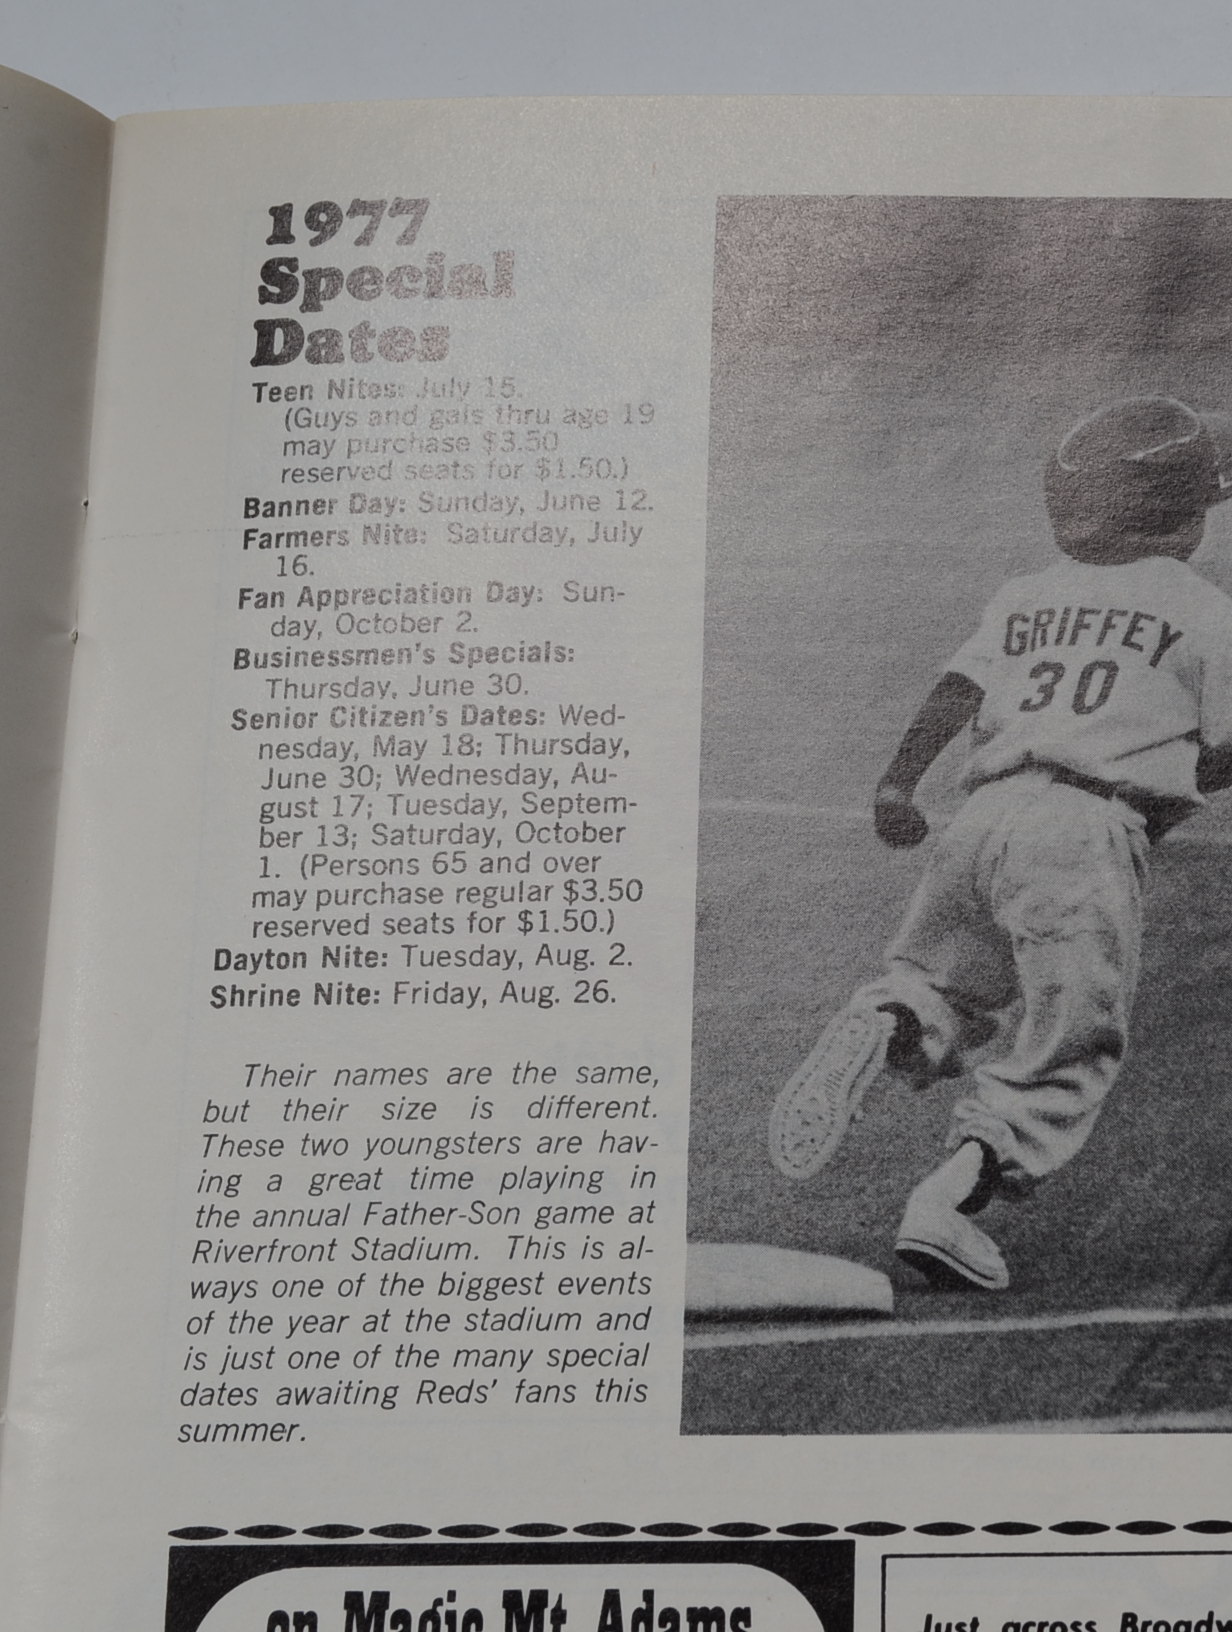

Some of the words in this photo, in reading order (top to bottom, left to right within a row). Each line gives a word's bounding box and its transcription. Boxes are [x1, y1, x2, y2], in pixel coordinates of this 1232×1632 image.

[266, 198, 430, 247] 1977
[258, 250, 516, 312] Special
[250, 318, 450, 367] Dates
[252, 382, 312, 403] Teen
[328, 379, 405, 401] Nites:
[416, 376, 470, 402] July
[285, 407, 357, 432] (Guys
[369, 404, 418, 427] and
[496, 404, 553, 426] thru
[562, 408, 608, 429] age
[624, 402, 655, 425] 19
[283, 440, 335, 460] may
[346, 432, 470, 459] purchase
[281, 460, 392, 484] reserved
[405, 460, 475, 480] seats
[487, 458, 523, 480] for
[535, 456, 629, 482] $1.50.)
[244, 497, 333, 519] Banner
[349, 492, 405, 518] Day:
[418, 491, 525, 516] Sunday,
[537, 490, 601, 512] June
[616, 489, 653, 511] 12.
[243, 528, 348, 550] Farmers
[363, 523, 426, 545] Nite:
[447, 521, 575, 548] Saturday,
[588, 520, 643, 547] July
[278, 554, 314, 577] 16.
[239, 588, 284, 609] Fan
[297, 582, 471, 612] Appreciation
[486, 581, 543, 608] Day:
[563, 580, 625, 603] Sun-
[271, 615, 322, 641] day,
[335, 612, 443, 635] October
[456, 610, 478, 632] 2.
[1002, 606, 1184, 668] GRIFFEY
[449, 640, 574, 669] Specials:
[265, 676, 397, 699] Thursday,
[409, 675, 474, 697] June
[487, 673, 528, 696] 30.
[1018, 660, 1120, 715] 30
[231, 707, 318, 731] Senior
[461, 704, 545, 726] Dates:
[559, 704, 625, 726] Wed-
[259, 737, 359, 763] nesday,
[373, 735, 427, 761] May
[442, 733, 482, 757] 18;
[495, 732, 629, 759] Thursday,
[261, 768, 326, 790] June
[340, 764, 381, 791] 30;
[395, 763, 558, 790] Wednesday,
[571, 762, 617, 784] Au-
[259, 797, 318, 825] gust
[333, 794, 372, 819] 17;
[387, 792, 507, 820] Tuesday,
[522, 791, 637, 819] Septem-
[259, 826, 303, 848] ber
[318, 824, 357, 850] 13;
[372, 823, 502, 849] Saturday,
[515, 820, 626, 844] October
[260, 856, 280, 878] 1.
[300, 853, 419, 880] (Persons
[432, 851, 467, 875] 65
[479, 851, 531, 874] and
[543, 856, 601, 873] over
[252, 890, 307, 911] may
[316, 881, 444, 912] purchase
[456, 880, 553, 909] regular
[563, 878, 643, 906] $3.50
[253, 913, 369, 938] reserved
[383, 912, 455, 936] seats
[467, 911, 506, 934] for
[518, 909, 614, 935] $1.50.)
[214, 948, 306, 975] Dayton
[322, 945, 387, 968] Nite:
[401, 944, 523, 971] Tuesday,
[535, 943, 595, 971] Aug.
[609, 942, 632, 966] 2.
[210, 984, 300, 1009] Shrine
[314, 983, 379, 1006] Nite:
[394, 981, 487, 1009] Friday,
[500, 980, 559, 1009] Aug.
[574, 979, 616, 1004] 26.
[245, 1063, 317, 1087] Their
[334, 1067, 428, 1086] names
[446, 1066, 492, 1085] are
[512, 1061, 557, 1085] the
[576, 1066, 658, 1087] same,
[203, 1100, 250, 1123] but
[283, 1097, 349, 1122] their
[382, 1096, 437, 1120] size
[470, 1095, 493, 1120] is
[527, 1095, 657, 1119] different.
[203, 1133, 284, 1158] These
[301, 1133, 349, 1156] two
[364, 1131, 521, 1161] youngsters
[537, 1136, 583, 1154] are
[599, 1130, 658, 1154] hav-
[197, 1169, 242, 1198] ing
[267, 1174, 282, 1192] a
[308, 1168, 383, 1197] great
[410, 1166, 474, 1190] time
[499, 1165, 604, 1195] playing
[630, 1165, 656, 1188] in
[196, 1204, 240, 1228] the
[252, 1203, 351, 1228] annual
[363, 1200, 520, 1226] Father-Son
[534, 1206, 615, 1230] game
[628, 1200, 655, 1224] at
[192, 1238, 337, 1264] Riverfront
[351, 1236, 478, 1261] Stadium.
[508, 1235, 566, 1260] This
[581, 1235, 604, 1260] is
[619, 1235, 653, 1260] al-
[191, 1280, 258, 1304] ways
[272, 1279, 324, 1298] one
[338, 1273, 366, 1297] of
[380, 1272, 424, 1297] the
[438, 1271, 544, 1301] biggest
[558, 1271, 652, 1296] events
[186, 1310, 215, 1335] of
[229, 1310, 273, 1334] the
[286, 1315, 350, 1339] year
[362, 1309, 391, 1333] at
[405, 1308, 451, 1333] the
[464, 1306, 582, 1332] stadium
[596, 1306, 652, 1331] and
[184, 1346, 207, 1371] is
[219, 1345, 275, 1375] just
[288, 1350, 340, 1369] one
[353, 1344, 382, 1369] of
[395, 1344, 440, 1368] the
[453, 1349, 533, 1373] many
[547, 1342, 650, 1373] special
[180, 1382, 258, 1406] dates
[276, 1380, 399, 1410] awaiting
[515, 1378, 576, 1403] fans
[596, 1378, 648, 1403] this
[178, 1422, 305, 1443] summer.
